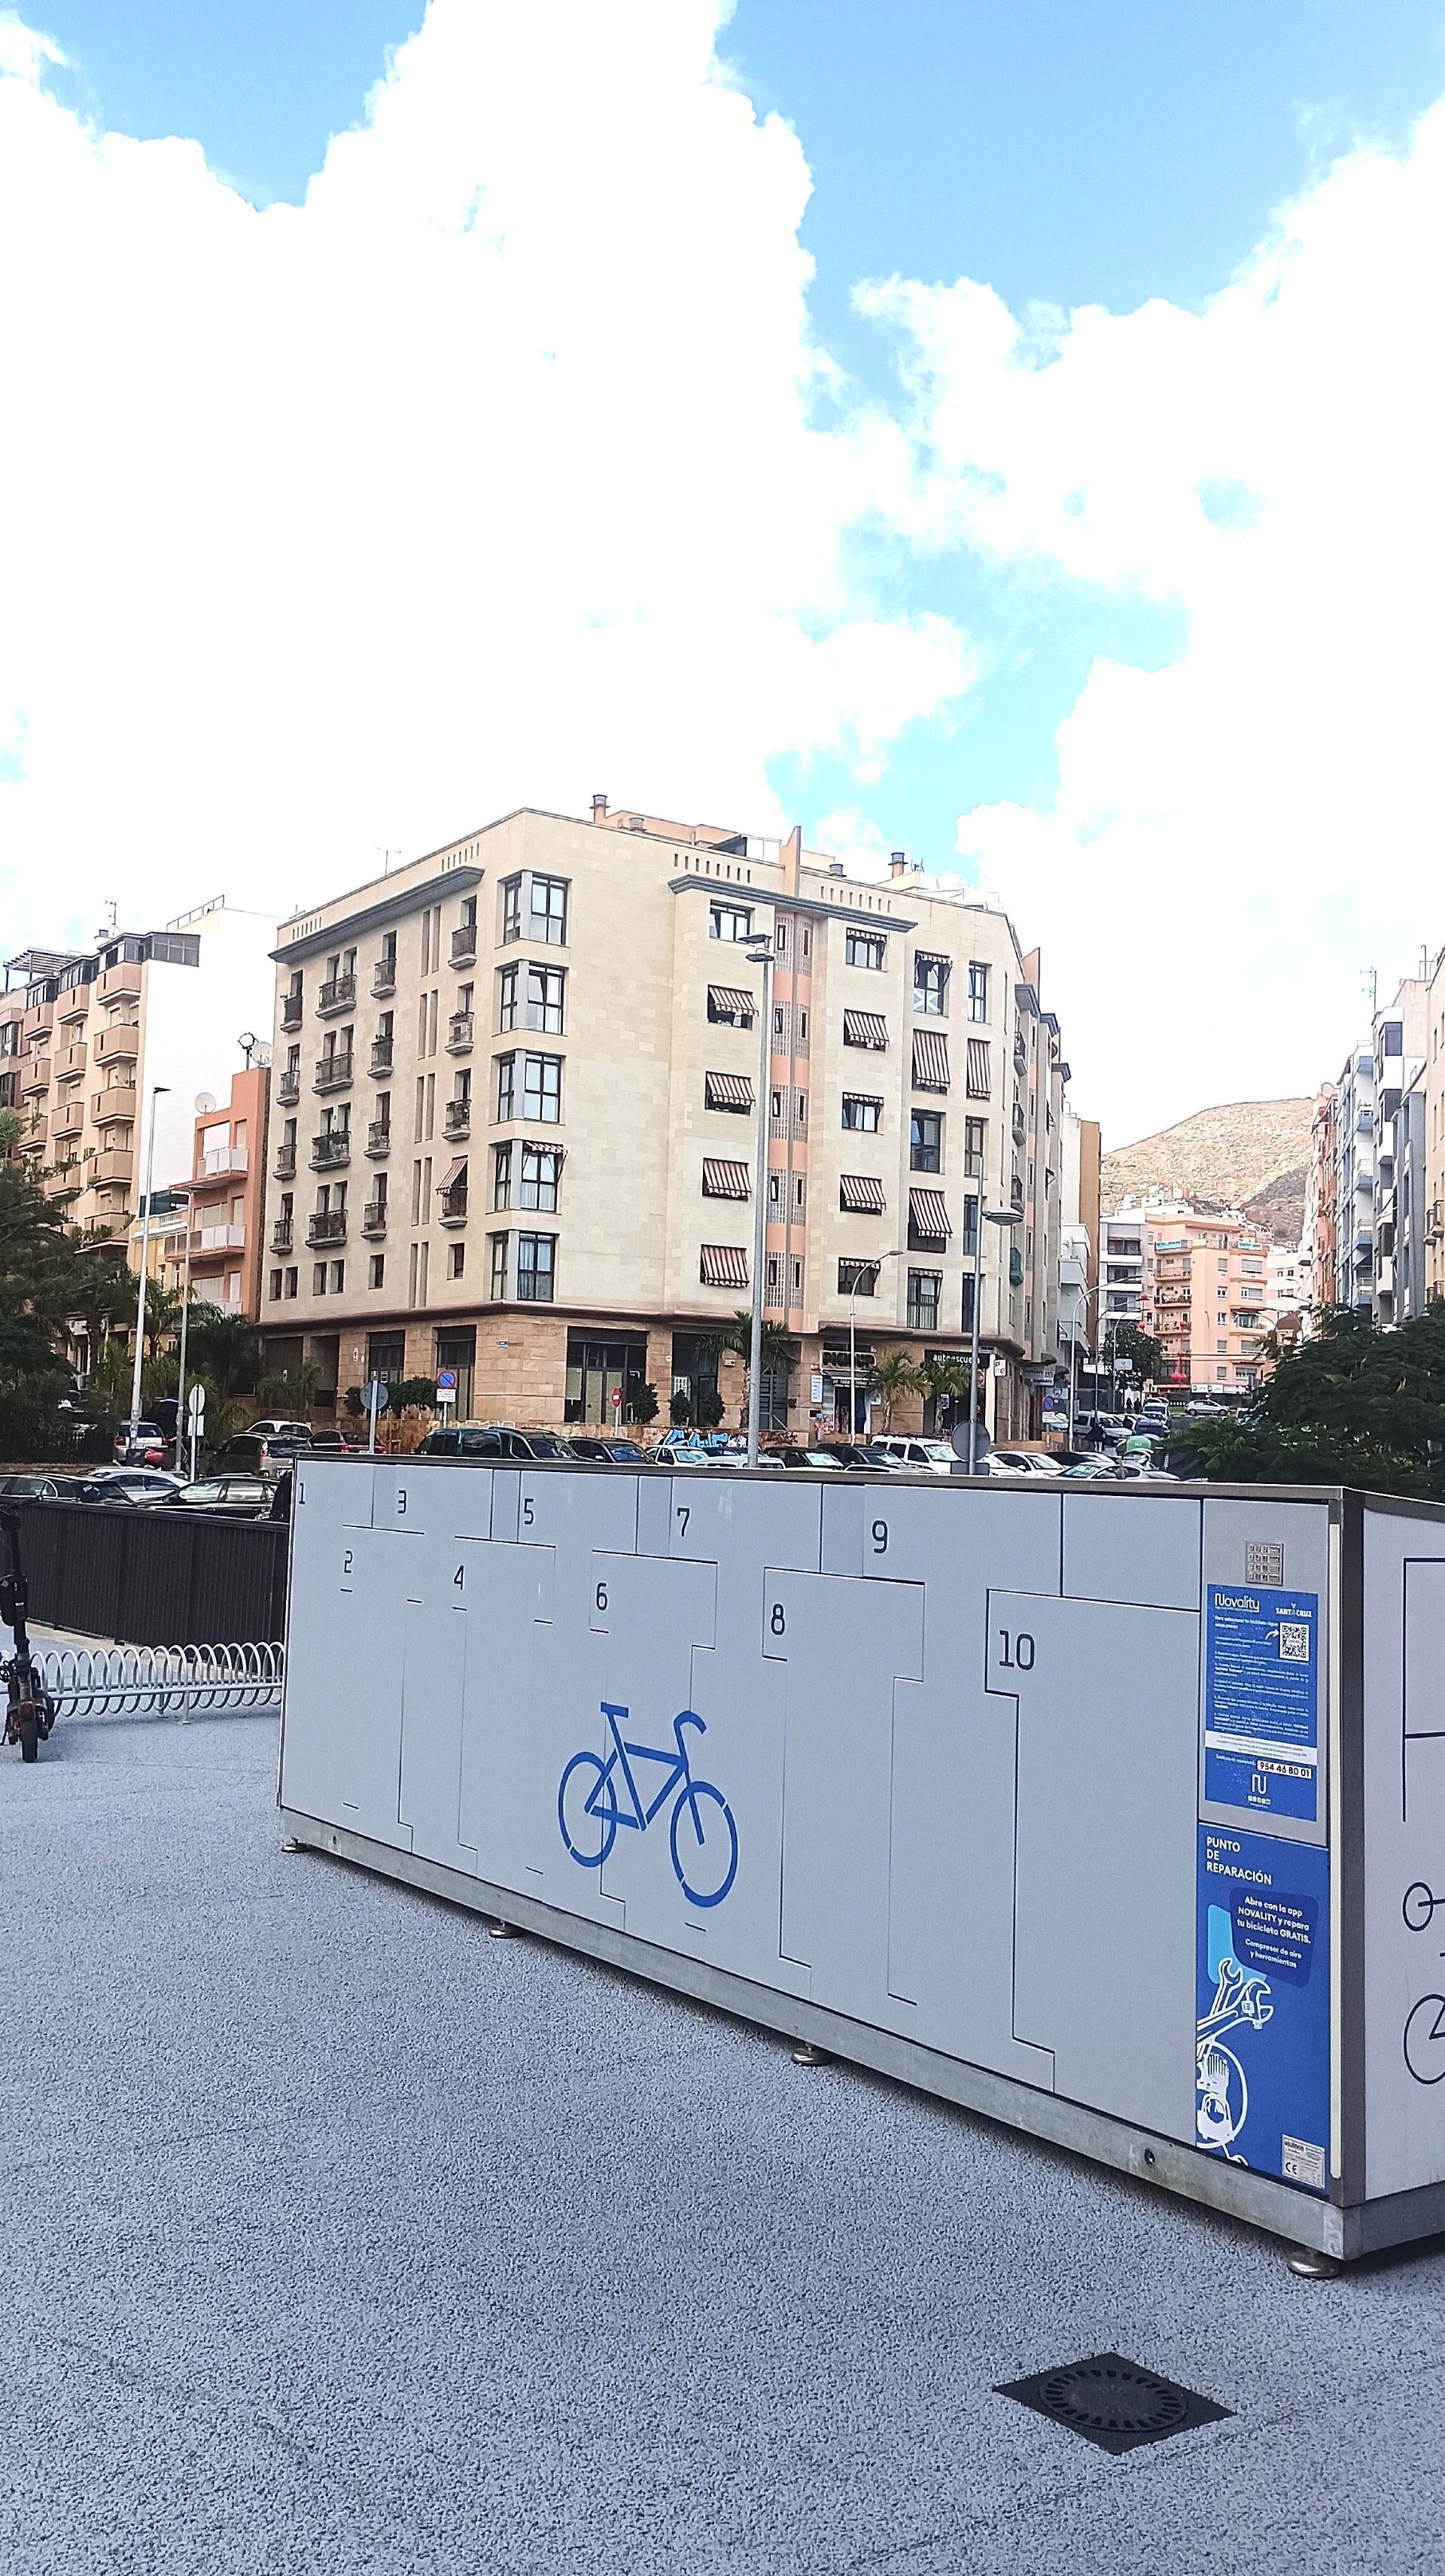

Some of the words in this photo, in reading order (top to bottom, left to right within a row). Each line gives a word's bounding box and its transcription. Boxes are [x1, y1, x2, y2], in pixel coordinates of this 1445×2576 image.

[933, 1354, 980, 1364] autoescuea
[298, 1482, 306, 1505] 1
[397, 1489, 407, 1514] 3
[524, 1498, 534, 1525] 5
[677, 1507, 690, 1537] 7
[872, 1520, 888, 1554] 9
[344, 1550, 353, 1574] 2
[453, 1565, 464, 1590] 4
[596, 1582, 608, 1611] 6
[1215, 1593, 1260, 1613] Novality
[771, 1603, 786, 1635] 8
[1296, 1609, 1313, 1618] CRUZ
[999, 1629, 1035, 1671] 10
[1260, 1762, 1275, 1771] 954
[1276, 1764, 1286, 1774] 46
[1288, 1766, 1299, 1775] 80
[1300, 1769, 1310, 1778] 01
[1206, 1836, 1240, 1852] PUNTO
[1206, 1849, 1220, 1860] DE
[1206, 1861, 1272, 1885] REPARACIÓN
[1238, 1906, 1276, 1923] NOVALITY
[1278, 1918, 1283, 1926] y
[1283, 1918, 1310, 1931] repara
[1245, 1896, 1263, 1907] Abre
[1264, 1902, 1277, 1911] con
[1279, 1903, 1286, 1913] la
[1288, 1908, 1303, 1918] app
[1237, 1918, 1245, 1927] tu
[1246, 1920, 1279, 1936] bicicleta
[1280, 1929, 1311, 1944] GRATIS.
[1245, 1938, 1279, 1953] Compresor
[1280, 1947, 1288, 1956] de
[1289, 1950, 1302, 1960] aire
[1255, 1950, 1297, 1968] herramientas
[1285, 2162, 1297, 2175] CE
